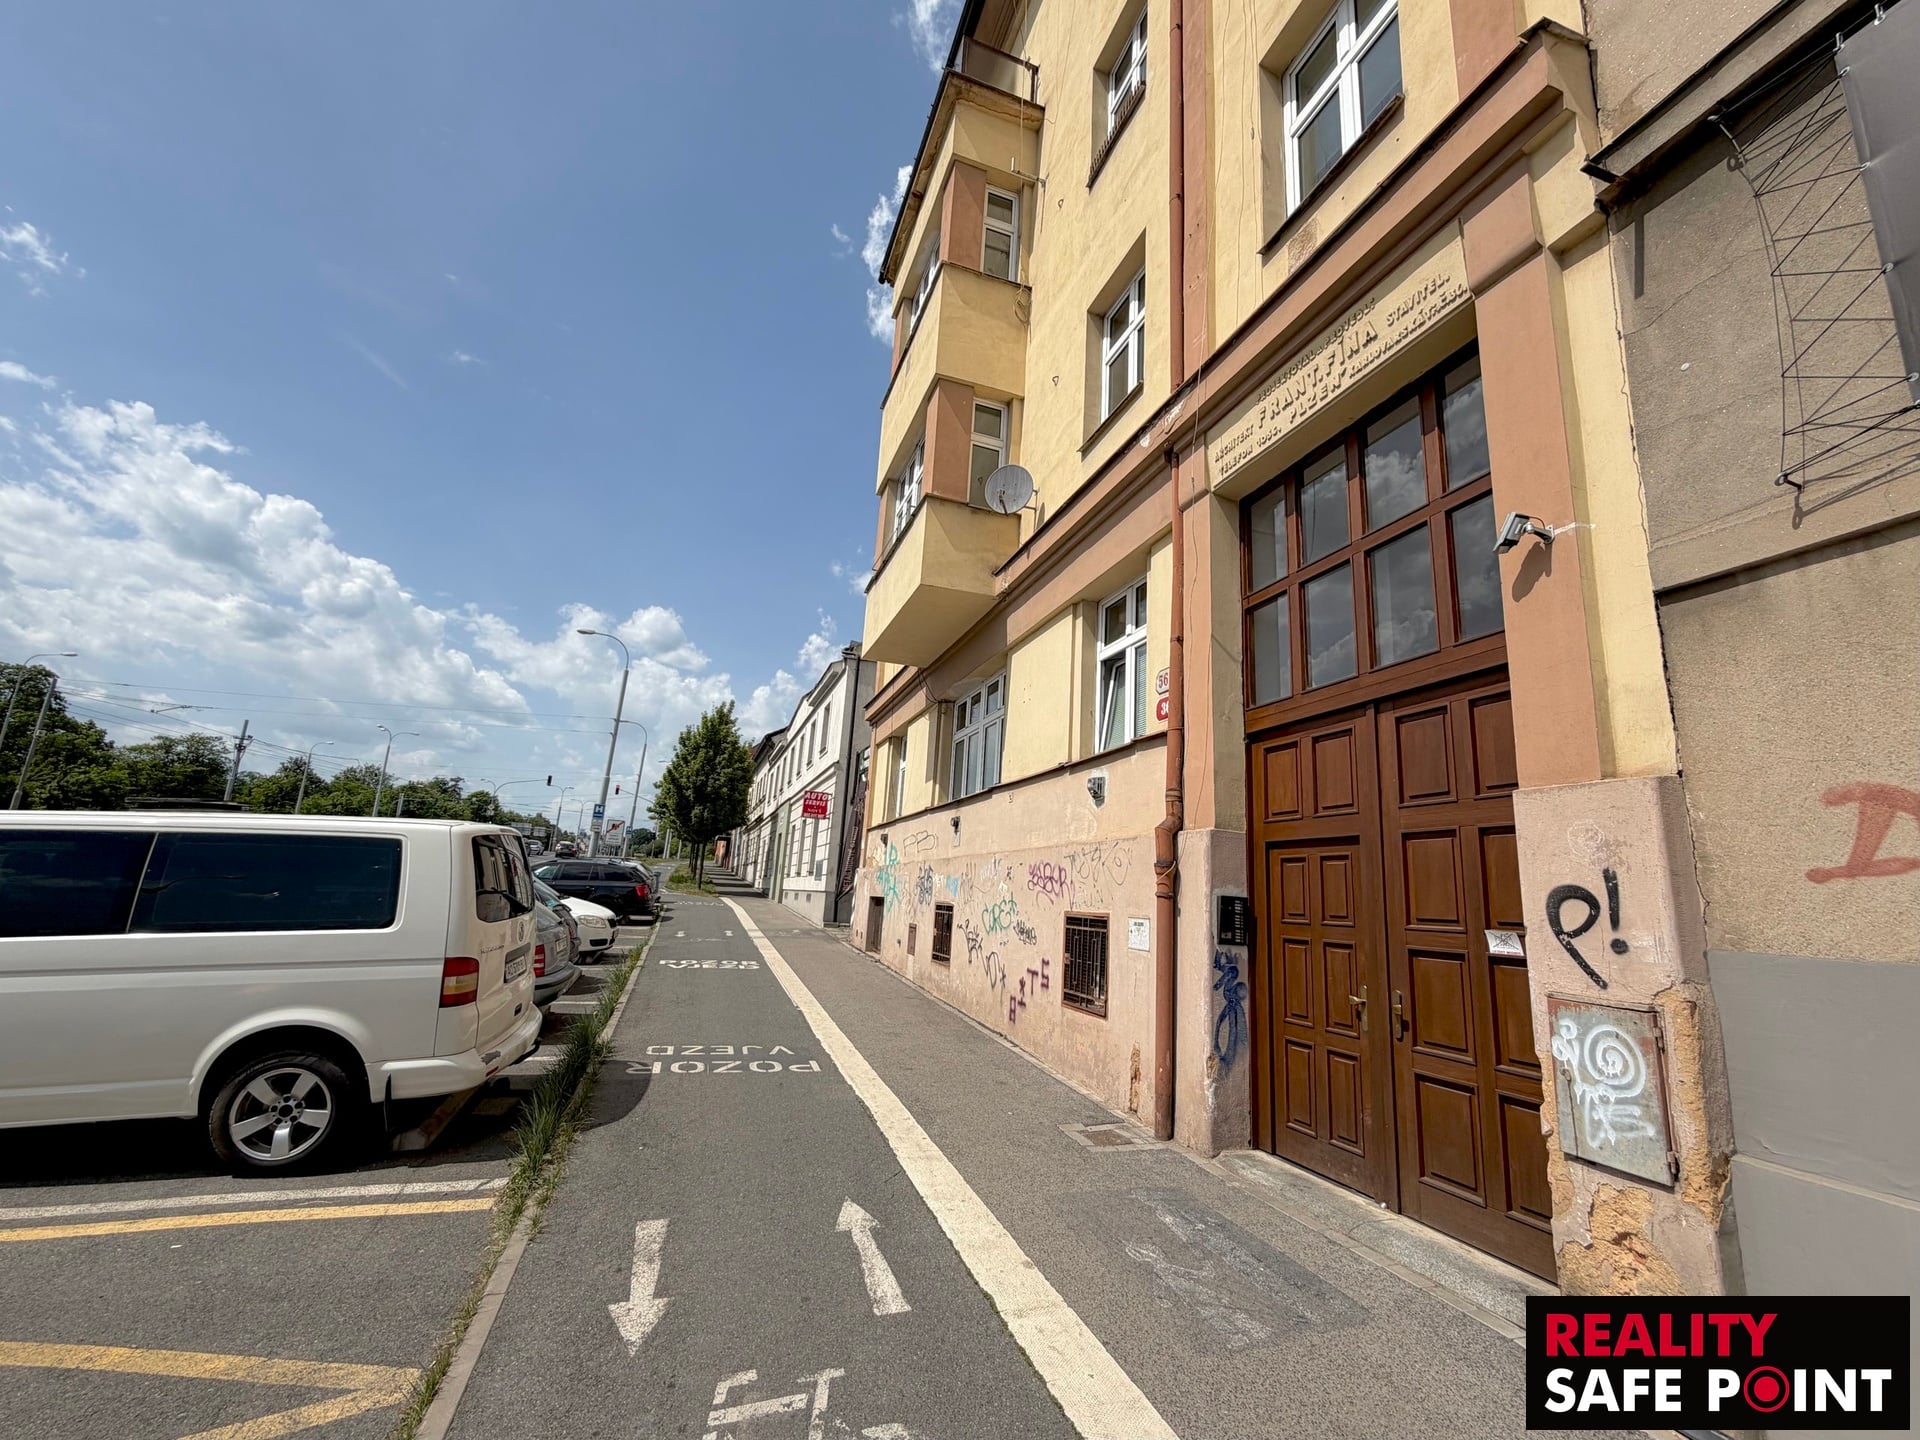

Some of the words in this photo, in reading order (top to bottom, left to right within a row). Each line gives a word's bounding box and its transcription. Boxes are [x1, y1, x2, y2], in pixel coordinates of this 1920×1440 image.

[1214, 425, 1254, 463] ARCHITEKT
[1219, 449, 1253, 476] TELEFON
[804, 792, 828, 800] AUTO
[645, 1045, 795, 1056] VJEZD
[625, 1060, 822, 1075] POZOR
